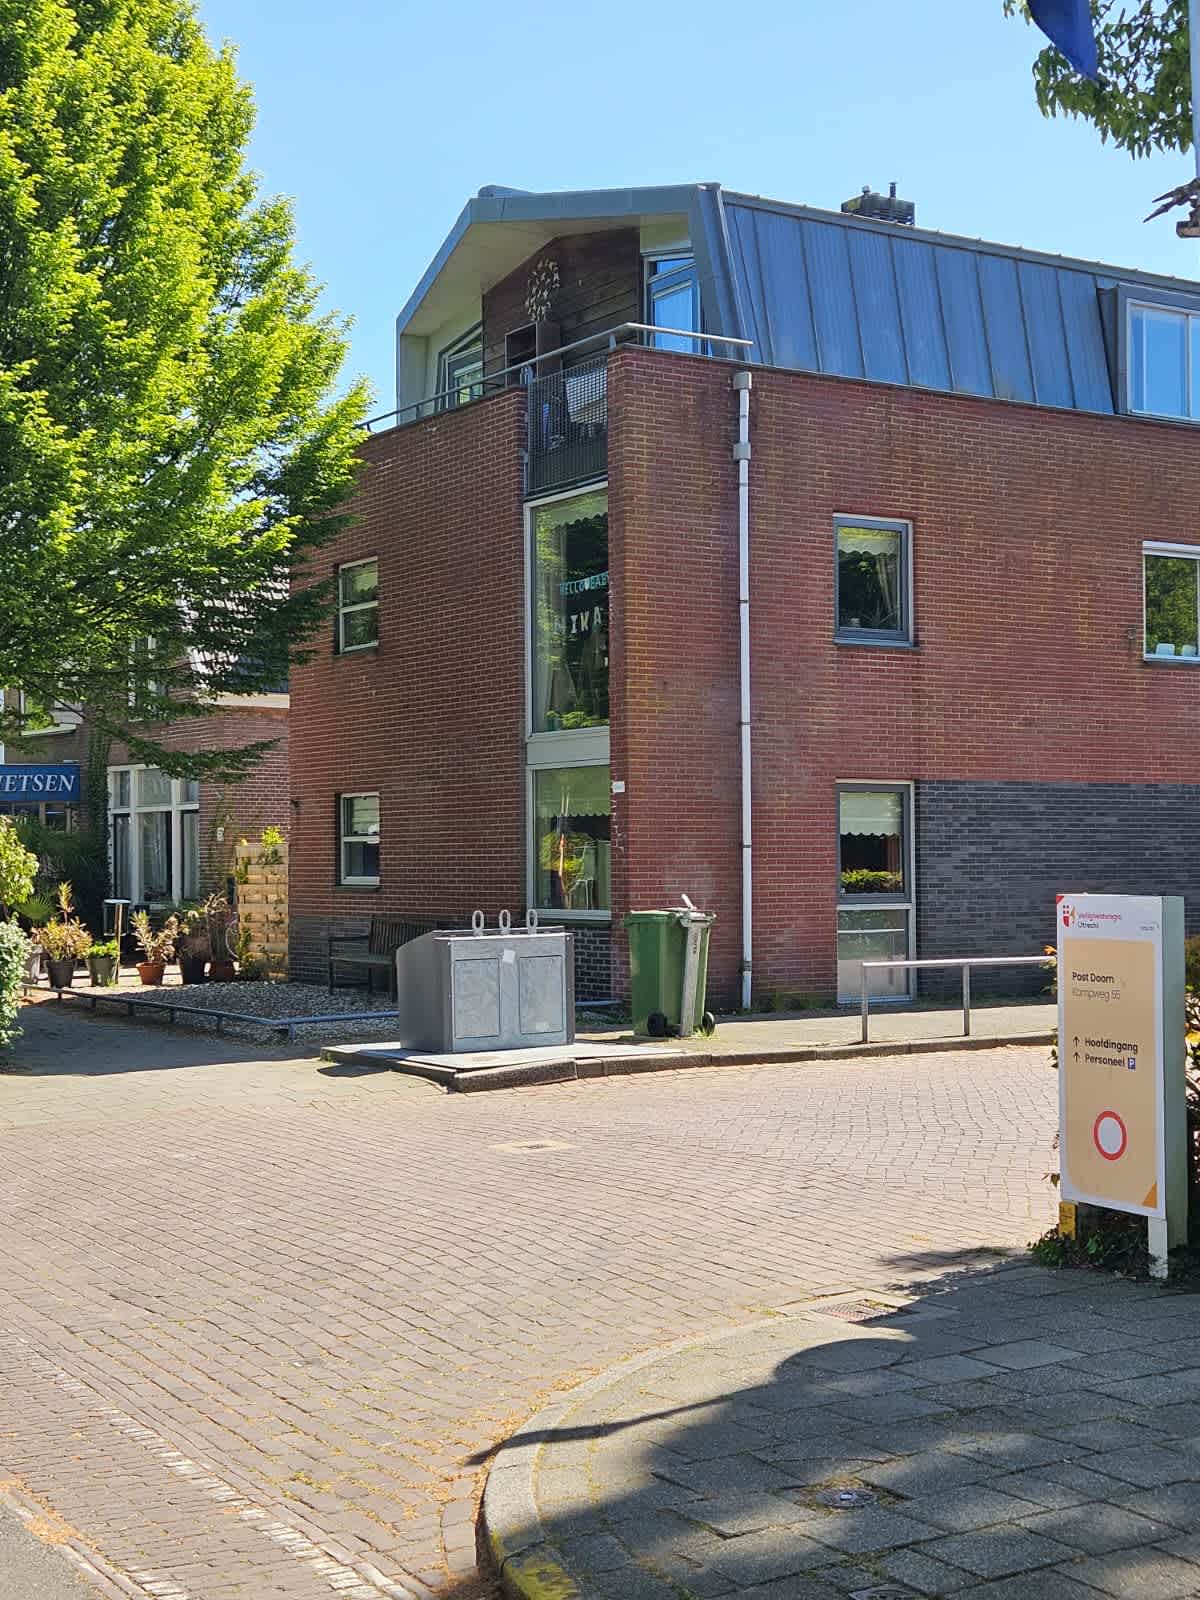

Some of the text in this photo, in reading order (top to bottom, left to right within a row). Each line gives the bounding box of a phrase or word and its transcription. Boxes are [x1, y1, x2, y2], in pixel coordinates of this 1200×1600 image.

[1071, 971, 1089, 983] Post
[1084, 1037, 1138, 1055] Hoofdingang
[1084, 1053, 1126, 1068] Personeel
